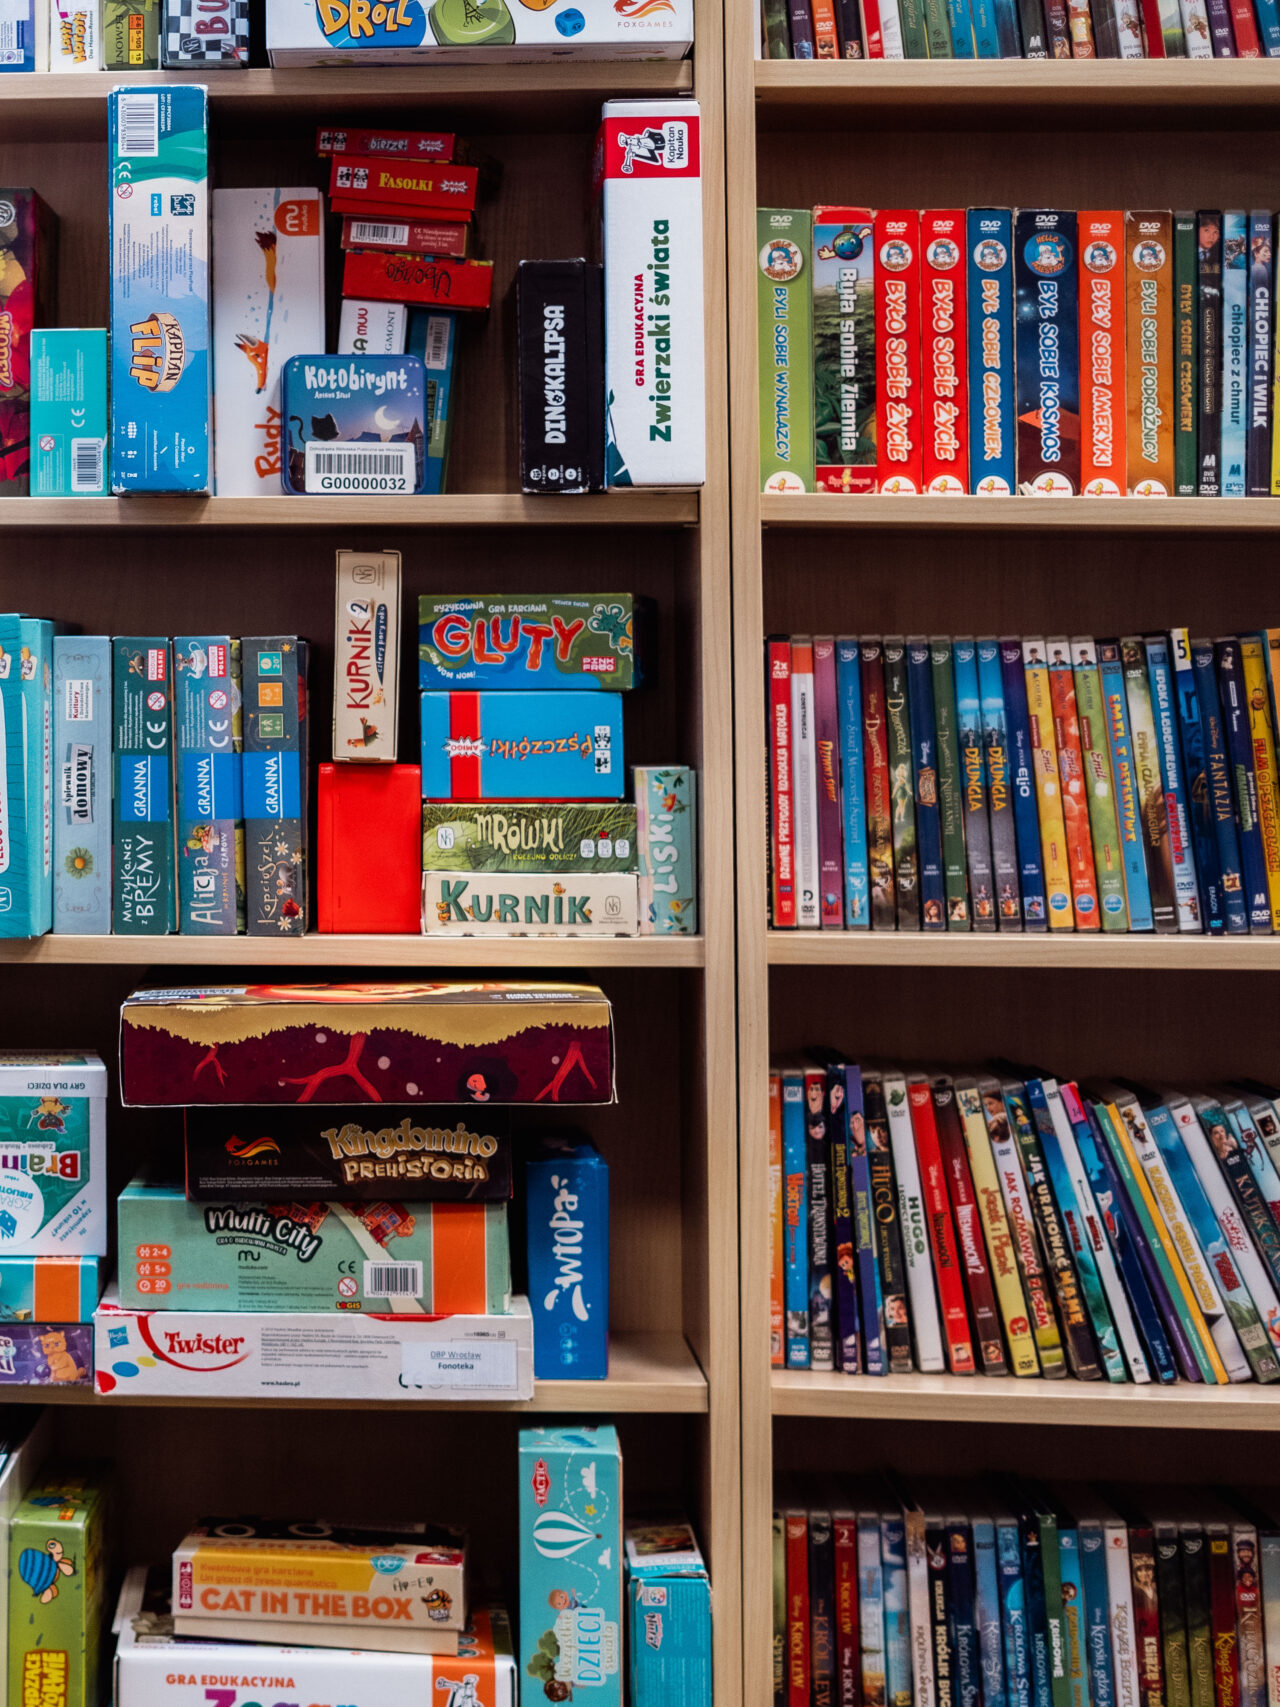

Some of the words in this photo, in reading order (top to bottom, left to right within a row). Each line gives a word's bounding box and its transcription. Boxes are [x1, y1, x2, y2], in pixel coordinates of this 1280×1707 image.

[61, 20, 73, 56] Lotti
[667, 125, 677, 164] Kapitan
[676, 128, 685, 160] Nauka
[379, 173, 434, 192] FASOLKI
[647, 219, 670, 306] świata
[775, 286, 788, 320] BYLI
[836, 268, 858, 314] Była
[885, 280, 906, 334] BYŁO
[932, 279, 954, 333] BYŁO
[1140, 280, 1157, 315] BYLI
[634, 273, 645, 362] EDUKACYJNA
[1230, 304, 1243, 364] chłopiec
[1254, 287, 1269, 370] CHŁOPIEC
[164, 322, 185, 382] KAPITAN
[775, 324, 789, 368] SOBIE
[839, 319, 856, 378] sobie
[982, 317, 1001, 369] SOBIE
[1039, 322, 1059, 378] SOBIE
[1092, 331, 1112, 385] SOBIE
[1141, 317, 1157, 363] SOBIE
[305, 363, 408, 396] Kotobirynt
[544, 304, 567, 445] DINOKALIPSA
[634, 367, 645, 387] GRA
[648, 314, 672, 443] Zwierzaki
[775, 371, 790, 462] WYNALAZCY
[841, 383, 860, 451] Ziemia
[983, 371, 1002, 461] CZŁOWIEK
[1040, 382, 1061, 463] KOSMOS
[1141, 366, 1161, 464] PODRÓŻNICY
[1231, 381, 1242, 425] chmur
[1253, 385, 1269, 428] WILK
[255, 406, 282, 479] Rudy
[1092, 387, 1113, 467] AMERYKI
[321, 477, 406, 490] G00000032
[351, 602, 370, 618] 2
[488, 604, 506, 613] GRA
[508, 604, 547, 613] KARCIANA
[218, 647, 226, 676] POLSKI
[433, 614, 585, 671] GLUTY
[1178, 640, 1187, 660] 5
[773, 660, 788, 670] 2x
[72, 691, 80, 719] Kultury
[1155, 669, 1168, 709] EPOKA
[775, 703, 787, 747] MATOŁKA
[450, 743, 480, 752] AMIGO
[1090, 751, 1108, 782] Emil
[1108, 693, 1126, 742] EMIL
[1117, 760, 1138, 843] DETEKTYWI
[1253, 738, 1268, 770] FILM
[73, 748, 93, 819] domowy
[134, 760, 148, 818] GRANNA
[198, 758, 211, 815] GRANNA
[266, 756, 278, 814] GRANNA
[965, 747, 983, 812] DŻUNGLA
[988, 747, 1007, 812] DŻUNGLA
[1210, 753, 1231, 822] FANTAZJA
[474, 813, 565, 854] MRÓWKI
[778, 793, 790, 842] PRZYGODY
[1260, 783, 1280, 874] PSZCZOŁACH
[136, 835, 161, 916] BREMY
[779, 845, 792, 880] DZIWNE
[441, 879, 592, 924] KURNIK
[1208, 886, 1218, 914] ERAGON
[27, 1082, 51, 1090] DZIECI
[53, 1082, 68, 1090] DLA
[70, 1082, 86, 1090] GRY
[321, 1118, 498, 1160] Kingdomino
[786, 1172, 805, 1227] HORTON
[810, 1163, 828, 1197] HOTEL
[871, 1165, 895, 1224] HUGO
[1004, 1171, 1021, 1196] JAK
[208, 1208, 270, 1236] Multi
[275, 1218, 320, 1261] City
[836, 1207, 850, 1218] 2
[908, 1195, 925, 1255] HUGO
[152, 1248, 168, 1257] 2-4
[956, 1204, 978, 1267] INIEMAMOCNI
[969, 1266, 985, 1275] 2
[1010, 1197, 1040, 1276] ROZMAWIAĆ
[1027, 1154, 1045, 1183] JAK
[1037, 1184, 1070, 1270] URATOWAĆ
[1059, 1270, 1085, 1326] MAMĘ
[155, 1266, 166, 1274] 5+
[155, 1280, 166, 1289] 20
[1030, 1290, 1050, 1328] PSEM
[164, 1330, 245, 1355] Twister
[448, 1350, 482, 1360] Wrocław
[261, 1379, 301, 1388] www.hasbro.pl
[438, 1361, 475, 1370] Fonoteka
[537, 1463, 546, 1502] TACTIC
[200, 1588, 254, 1612] CAT
[261, 1592, 288, 1613] IN
[291, 1593, 347, 1617] THE
[352, 1596, 414, 1620] BOX
[934, 1580, 946, 1621] KOLEKCJA
[578, 1612, 602, 1682] DZIECI
[790, 1621, 805, 1657] KRÓL
[936, 1625, 950, 1677] KRÓLIK
[1049, 1618, 1065, 1679] KRUDOWIE
[166, 1673, 198, 1687] GRA
[200, 1674, 296, 1688] EDUKACYJNA
[791, 1659, 805, 1690] LEW
